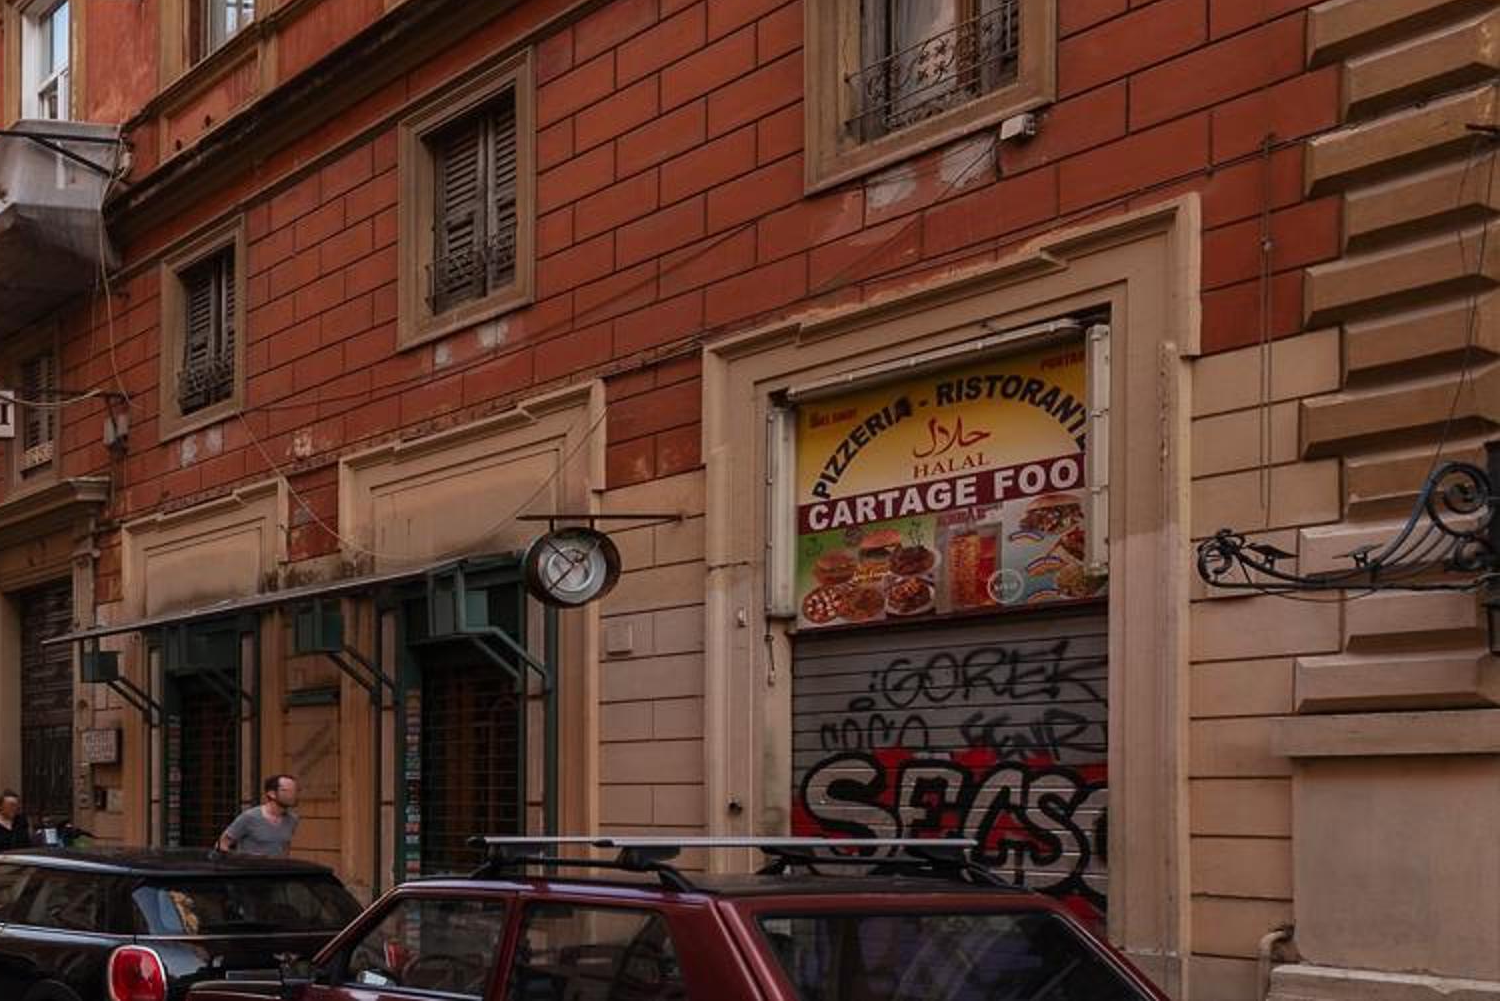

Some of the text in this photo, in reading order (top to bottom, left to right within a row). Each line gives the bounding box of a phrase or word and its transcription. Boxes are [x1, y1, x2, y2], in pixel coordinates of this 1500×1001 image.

[811, 394, 912, 500] PIZZERIA
[912, 414, 991, 460] حلال
[913, 452, 991, 480] HALAL
[808, 473, 977, 532] CARTAGE
